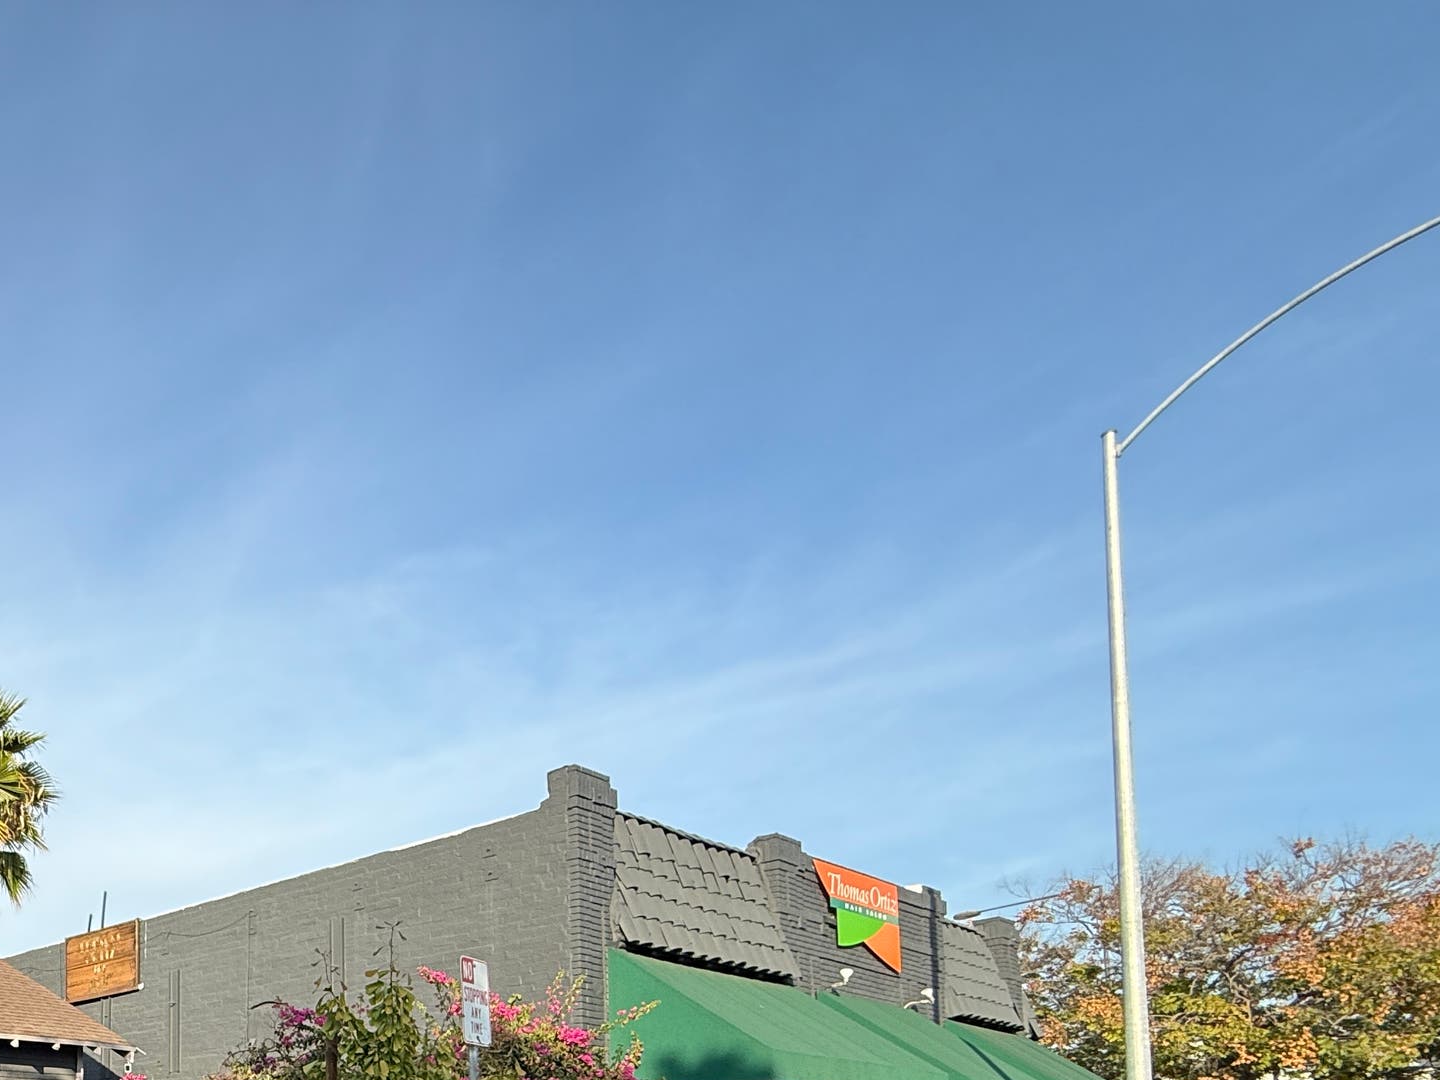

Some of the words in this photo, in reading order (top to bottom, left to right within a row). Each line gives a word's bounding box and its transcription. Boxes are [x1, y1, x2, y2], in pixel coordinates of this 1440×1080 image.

[827, 871, 869, 904] Thomas
[869, 886, 898, 913] Ortiz
[844, 902, 863, 913] HAIR
[865, 908, 888, 920] SALON
[463, 960, 473, 980] NO
[471, 1006, 482, 1019] ANY
[471, 1021, 483, 1035] TIME
